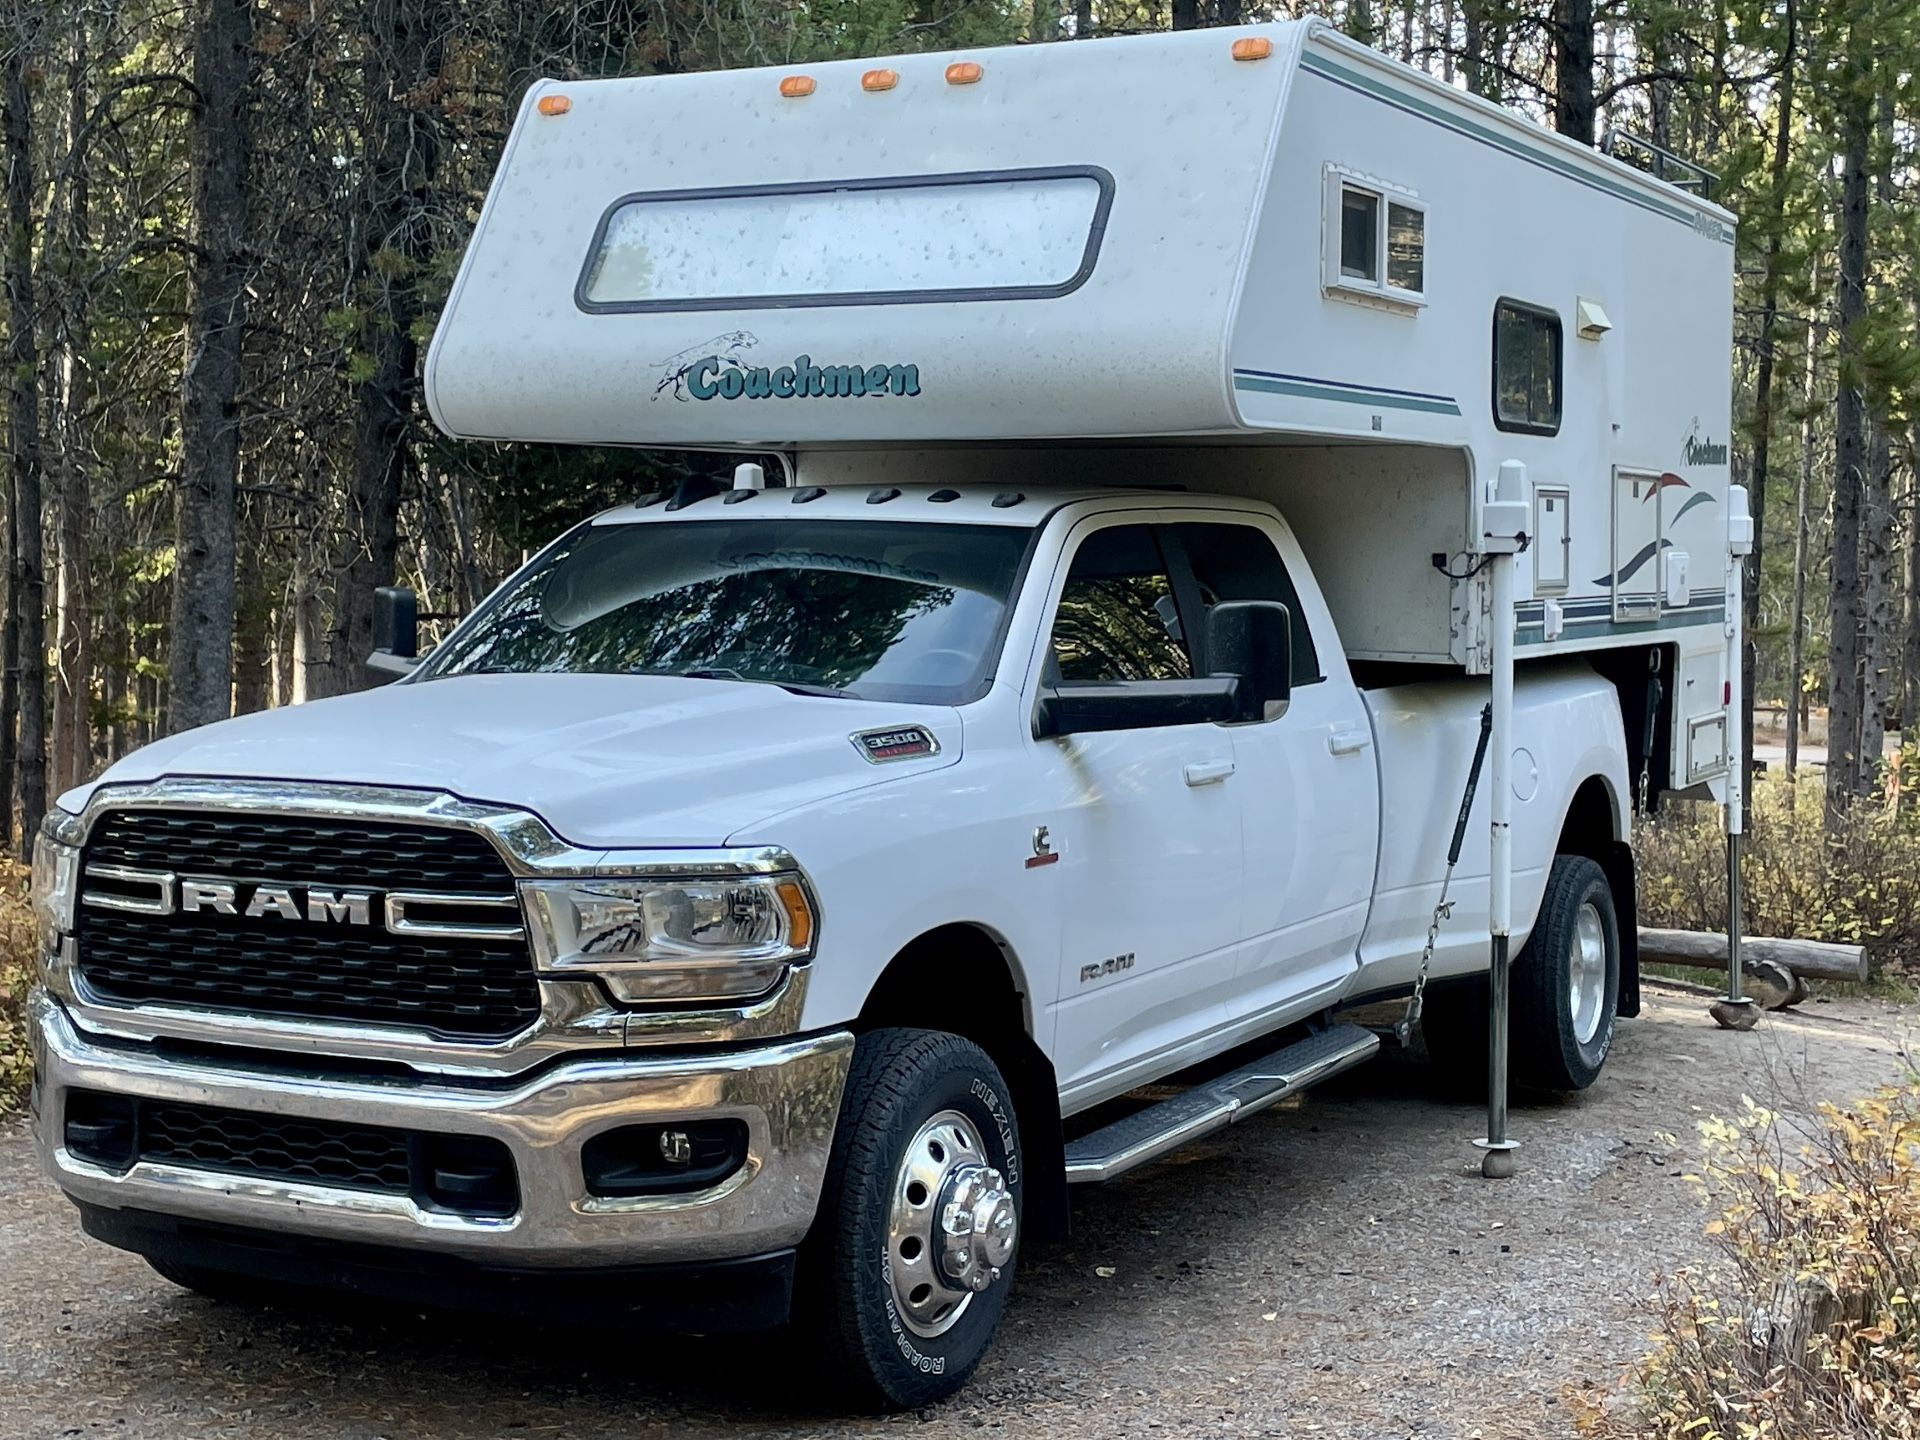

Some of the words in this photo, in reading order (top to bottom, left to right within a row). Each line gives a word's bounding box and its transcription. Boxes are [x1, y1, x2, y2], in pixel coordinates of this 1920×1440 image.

[687, 354, 921, 400] Coachmen
[867, 731, 921, 748] 3500
[182, 880, 371, 925] RAM
[1080, 952, 1135, 982] RAM
[970, 1078, 1018, 1185] NEXEN
[886, 1299, 945, 1375] ROADIAN
